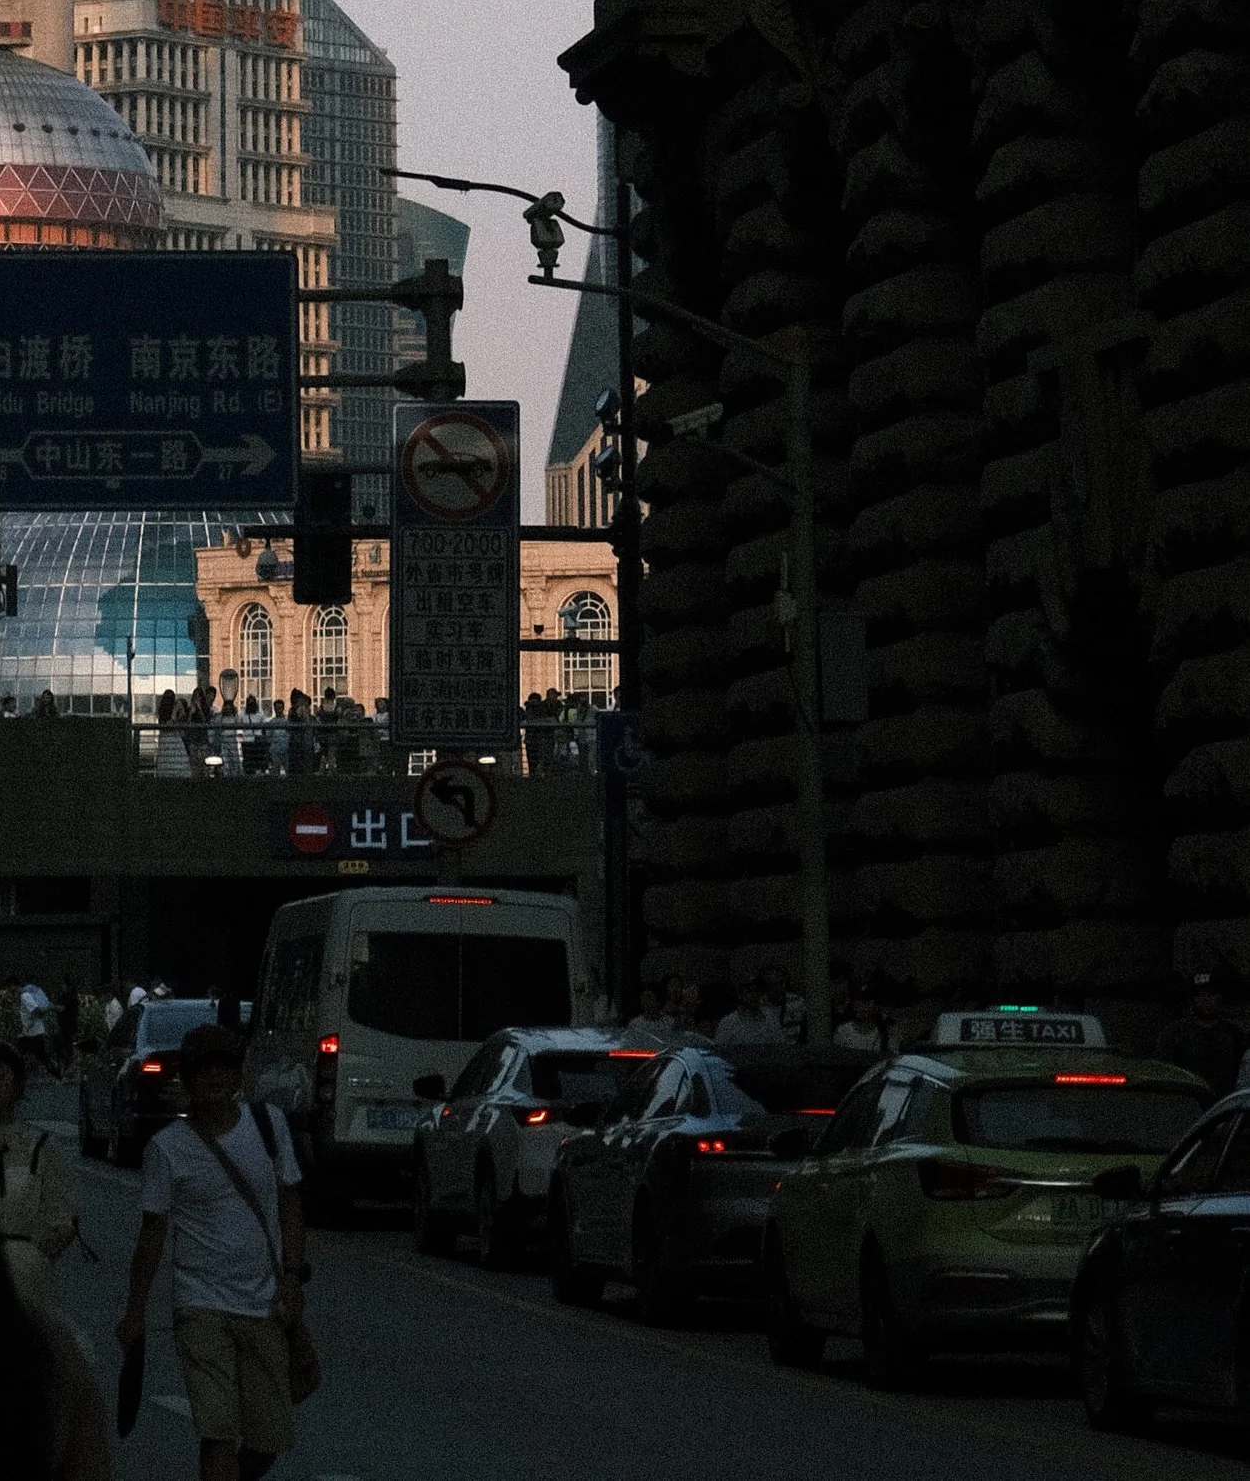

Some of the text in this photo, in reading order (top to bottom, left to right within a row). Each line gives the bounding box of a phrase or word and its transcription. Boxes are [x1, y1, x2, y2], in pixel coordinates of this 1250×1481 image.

[129, 333, 283, 381] 南京东路
[36, 390, 95, 419] Bridge
[130, 390, 200, 419] Nanjing
[258, 389, 284, 414] (E)
[36, 438, 188, 472] 中山东一路
[416, 591, 494, 613] 出租空车
[970, 1020, 1076, 1040] 强生 TAXI
